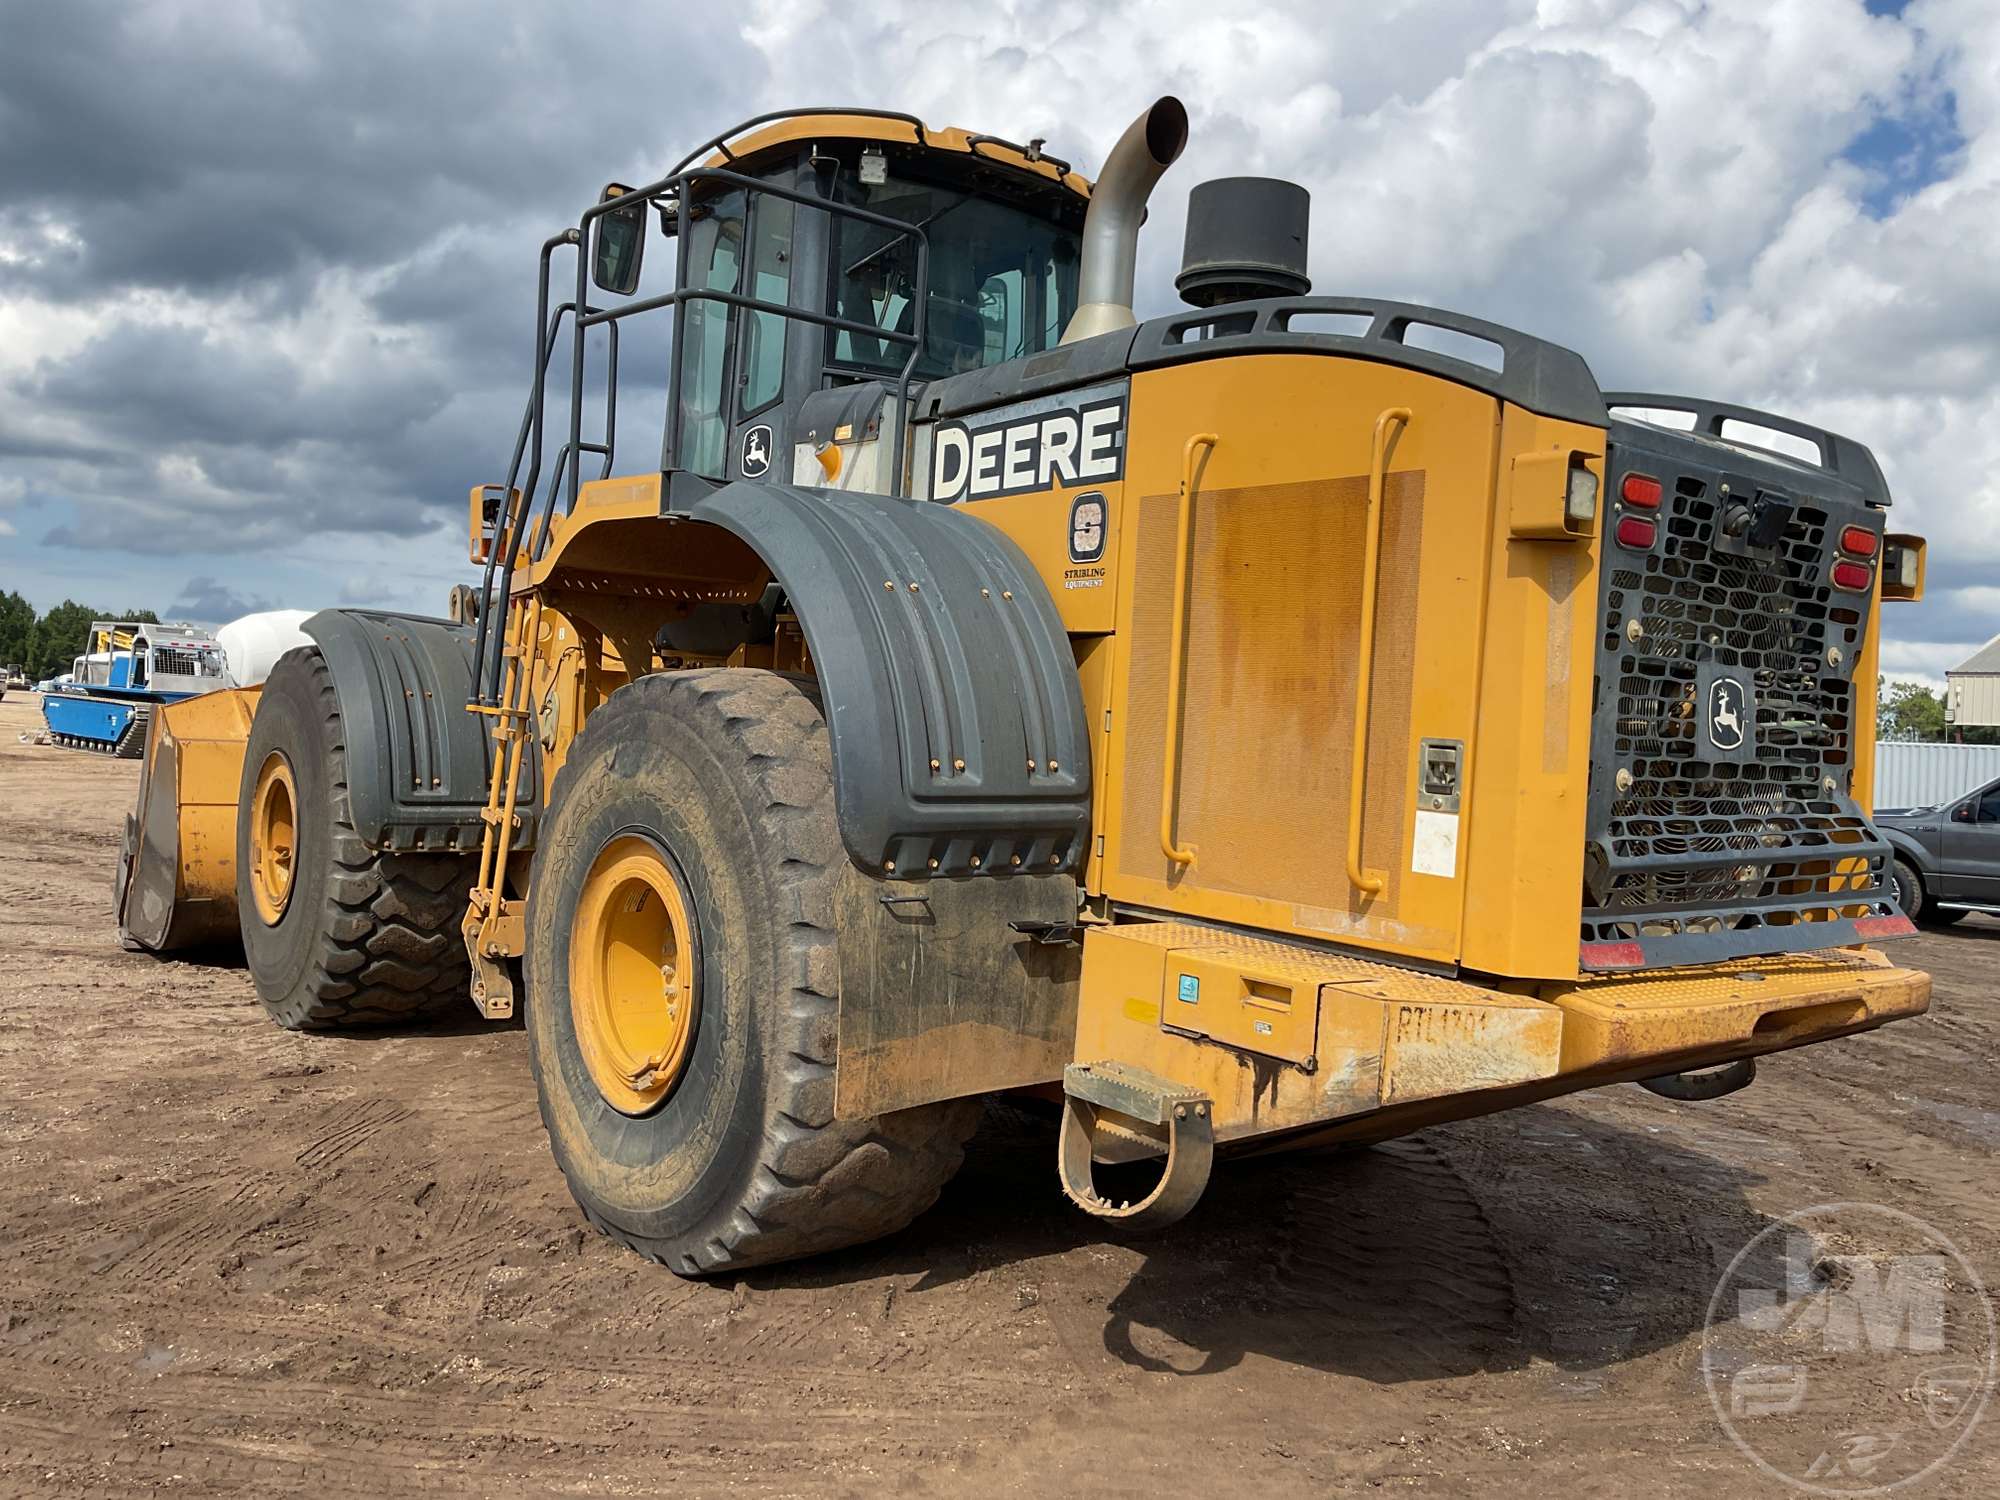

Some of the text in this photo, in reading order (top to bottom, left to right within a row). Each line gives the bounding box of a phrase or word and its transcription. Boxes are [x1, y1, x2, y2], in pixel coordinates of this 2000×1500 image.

[933, 405, 1120, 500] DEERE
[1064, 568, 1106, 579] STRIBLING
[1065, 579, 1104, 589] EQUIPMENT
